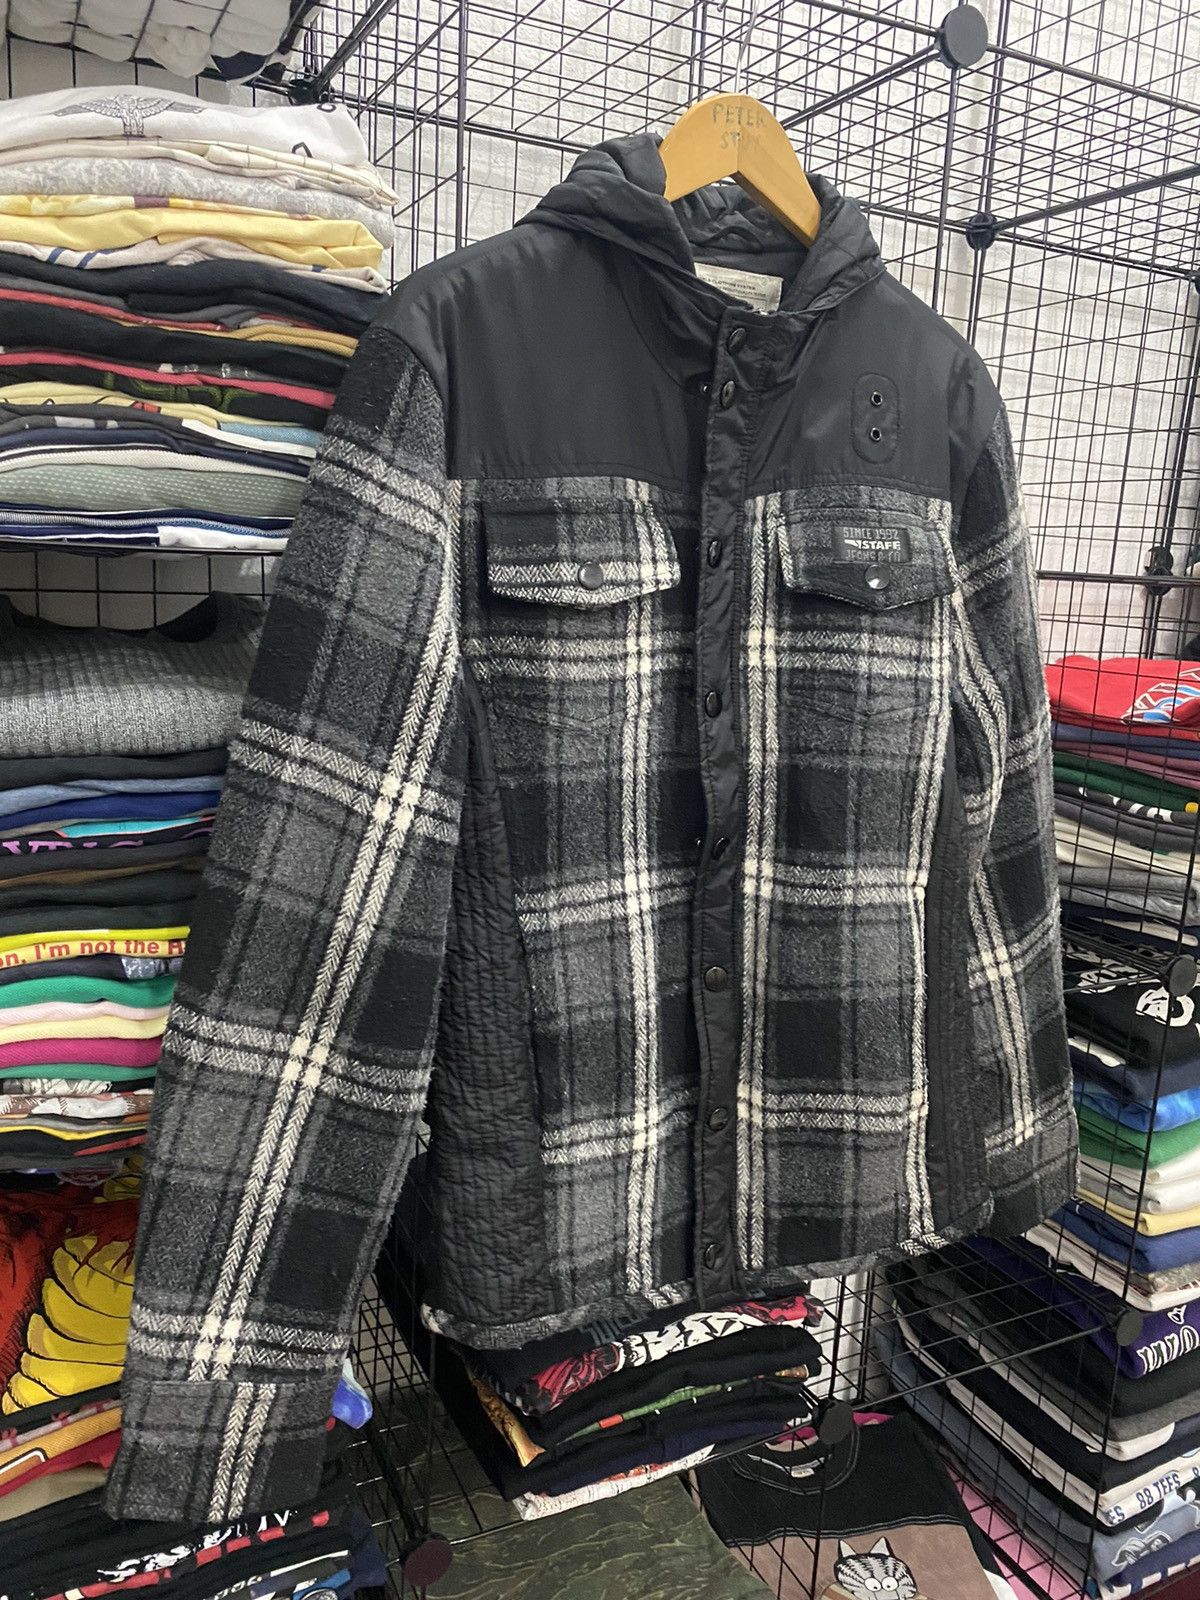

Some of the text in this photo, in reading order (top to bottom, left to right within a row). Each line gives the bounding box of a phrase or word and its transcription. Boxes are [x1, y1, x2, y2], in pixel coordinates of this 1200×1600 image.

[712, 103, 768, 128] PETER
[842, 526, 872, 539] SINCE
[862, 540, 901, 550] STAFF
[34, 943, 70, 960] I'm
[80, 940, 116, 955] not
[124, 940, 159, 954] the
[1136, 1487, 1154, 1510] 88
[1153, 1472, 1181, 1499] TEES
